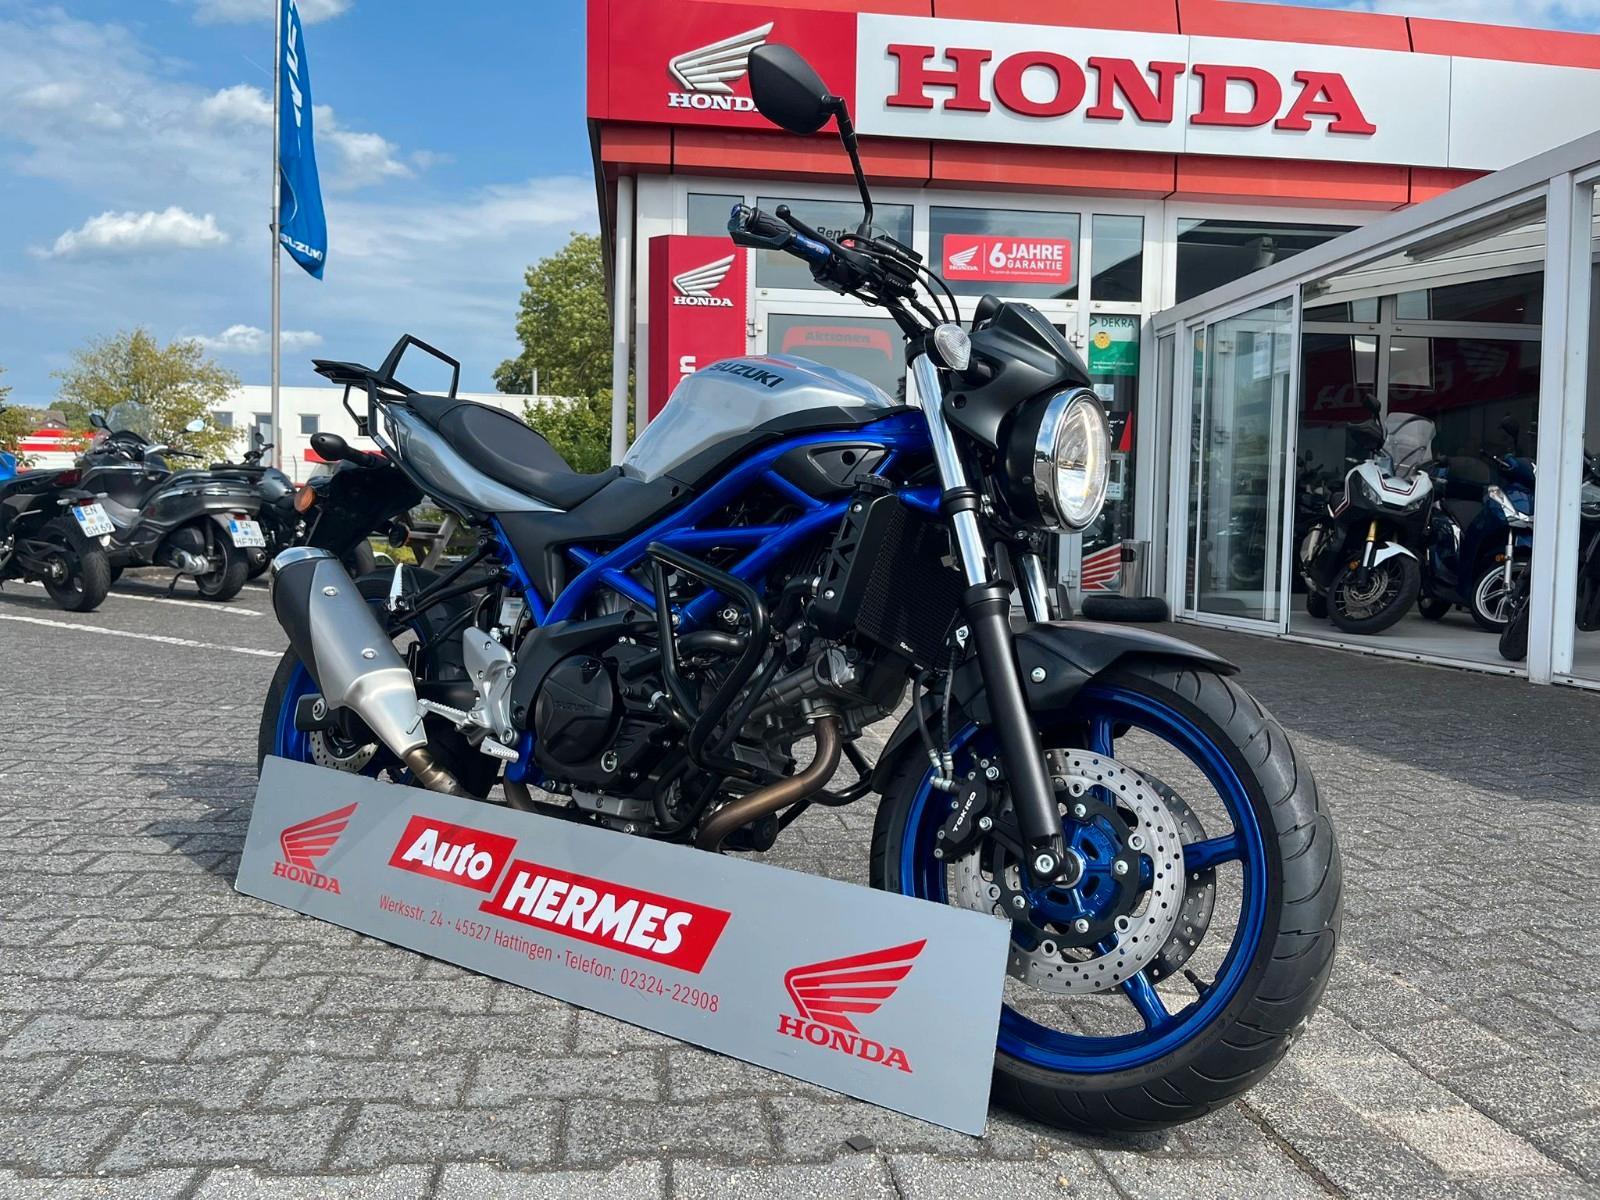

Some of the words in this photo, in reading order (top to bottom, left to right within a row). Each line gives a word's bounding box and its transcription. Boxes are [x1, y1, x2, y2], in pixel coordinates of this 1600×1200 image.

[668, 92, 759, 112] HOND
[886, 44, 1377, 135] HONDA
[989, 242, 1006, 268] 6
[1007, 243, 1063, 260] JAHRE
[1007, 260, 1063, 271] GARANTIE
[673, 296, 734, 307] HONDA
[1101, 317, 1135, 329] DEKRA
[709, 362, 784, 388] SUZUKI
[952, 791, 977, 833] TOKICO
[401, 828, 494, 881] Auto
[272, 860, 342, 896] HONDA
[502, 870, 693, 954] HERMES
[378, 894, 426, 923] Werksstr.
[430, 910, 444, 928] 24
[455, 918, 492, 942] 45527
[494, 928, 553, 961] Hattingen
[565, 950, 617, 982] Telefon:
[620, 967, 720, 1013] 02324-22908
[776, 1013, 914, 1074] HONDA
